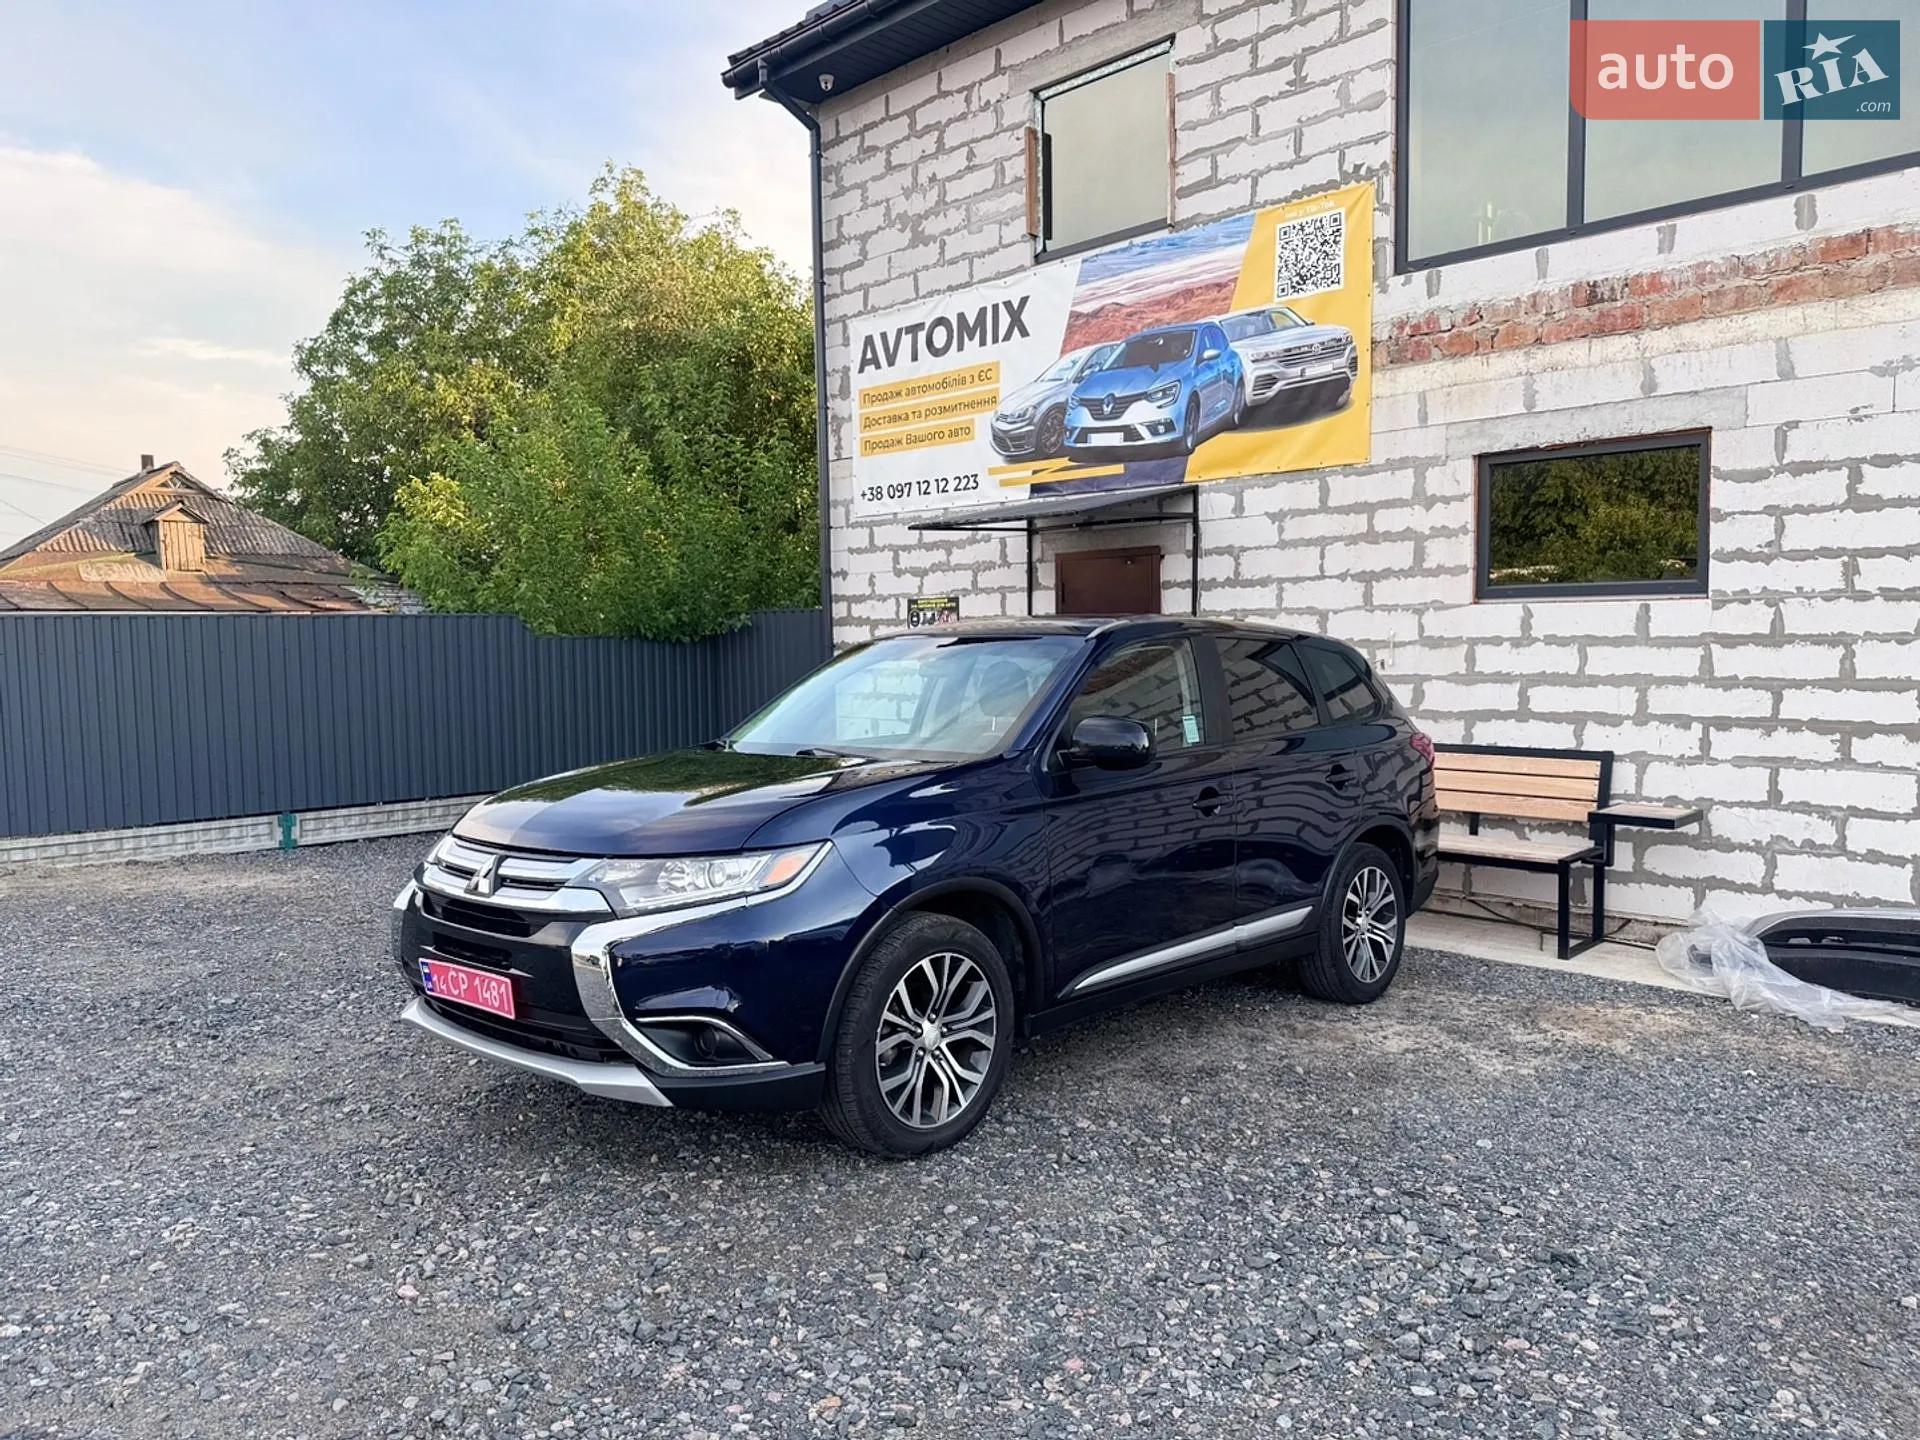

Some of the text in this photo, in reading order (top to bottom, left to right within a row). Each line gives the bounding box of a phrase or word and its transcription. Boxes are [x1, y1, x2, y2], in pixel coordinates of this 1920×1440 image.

[858, 295, 1031, 374] AVTOMIX
[863, 368, 993, 406] Продаж автомобілів з ЄС
[863, 395, 998, 430] Доставка та розмитнення
[864, 426, 971, 454] Продаж Вашого авто
[861, 473, 979, 502] +38 097 12 12 223
[474, 976, 509, 1011] 1481
